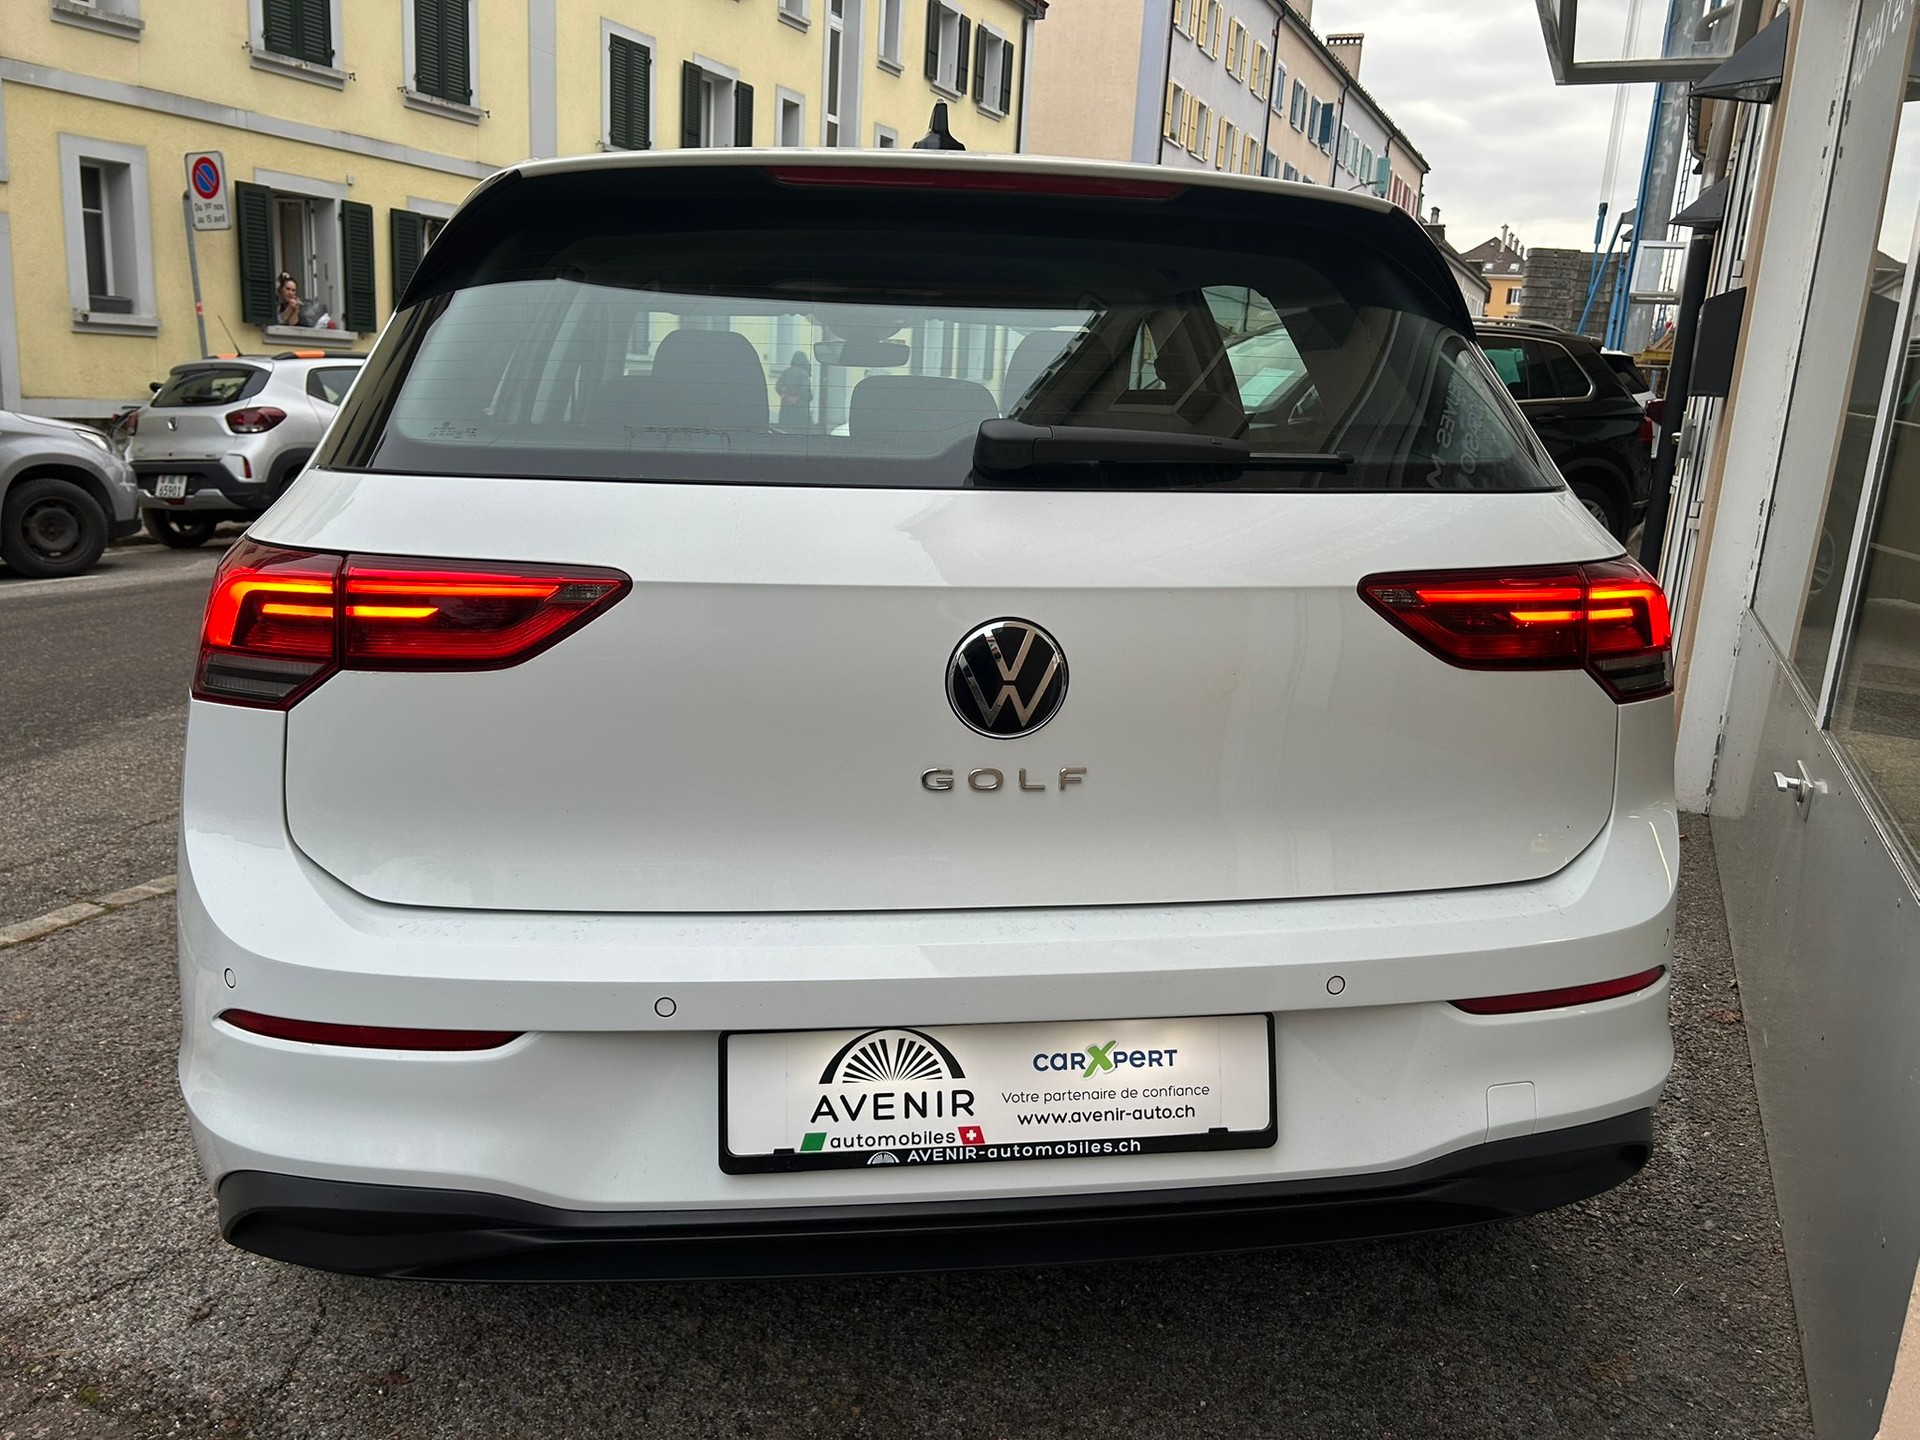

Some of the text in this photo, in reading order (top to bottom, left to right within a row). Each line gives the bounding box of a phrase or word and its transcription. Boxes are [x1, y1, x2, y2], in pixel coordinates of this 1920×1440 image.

[205, 214, 212, 223] 15
[213, 213, 226, 223] avril
[920, 766, 1088, 792] GOLF
[1001, 1083, 1210, 1105] Votre partenaire de confiance
[810, 1089, 975, 1124] AVENIR
[1017, 1104, 1196, 1126] www.avenir-auto.ch
[829, 1130, 957, 1149] automobiles
[906, 1139, 1142, 1164] AVENIR-automobiles.ch
